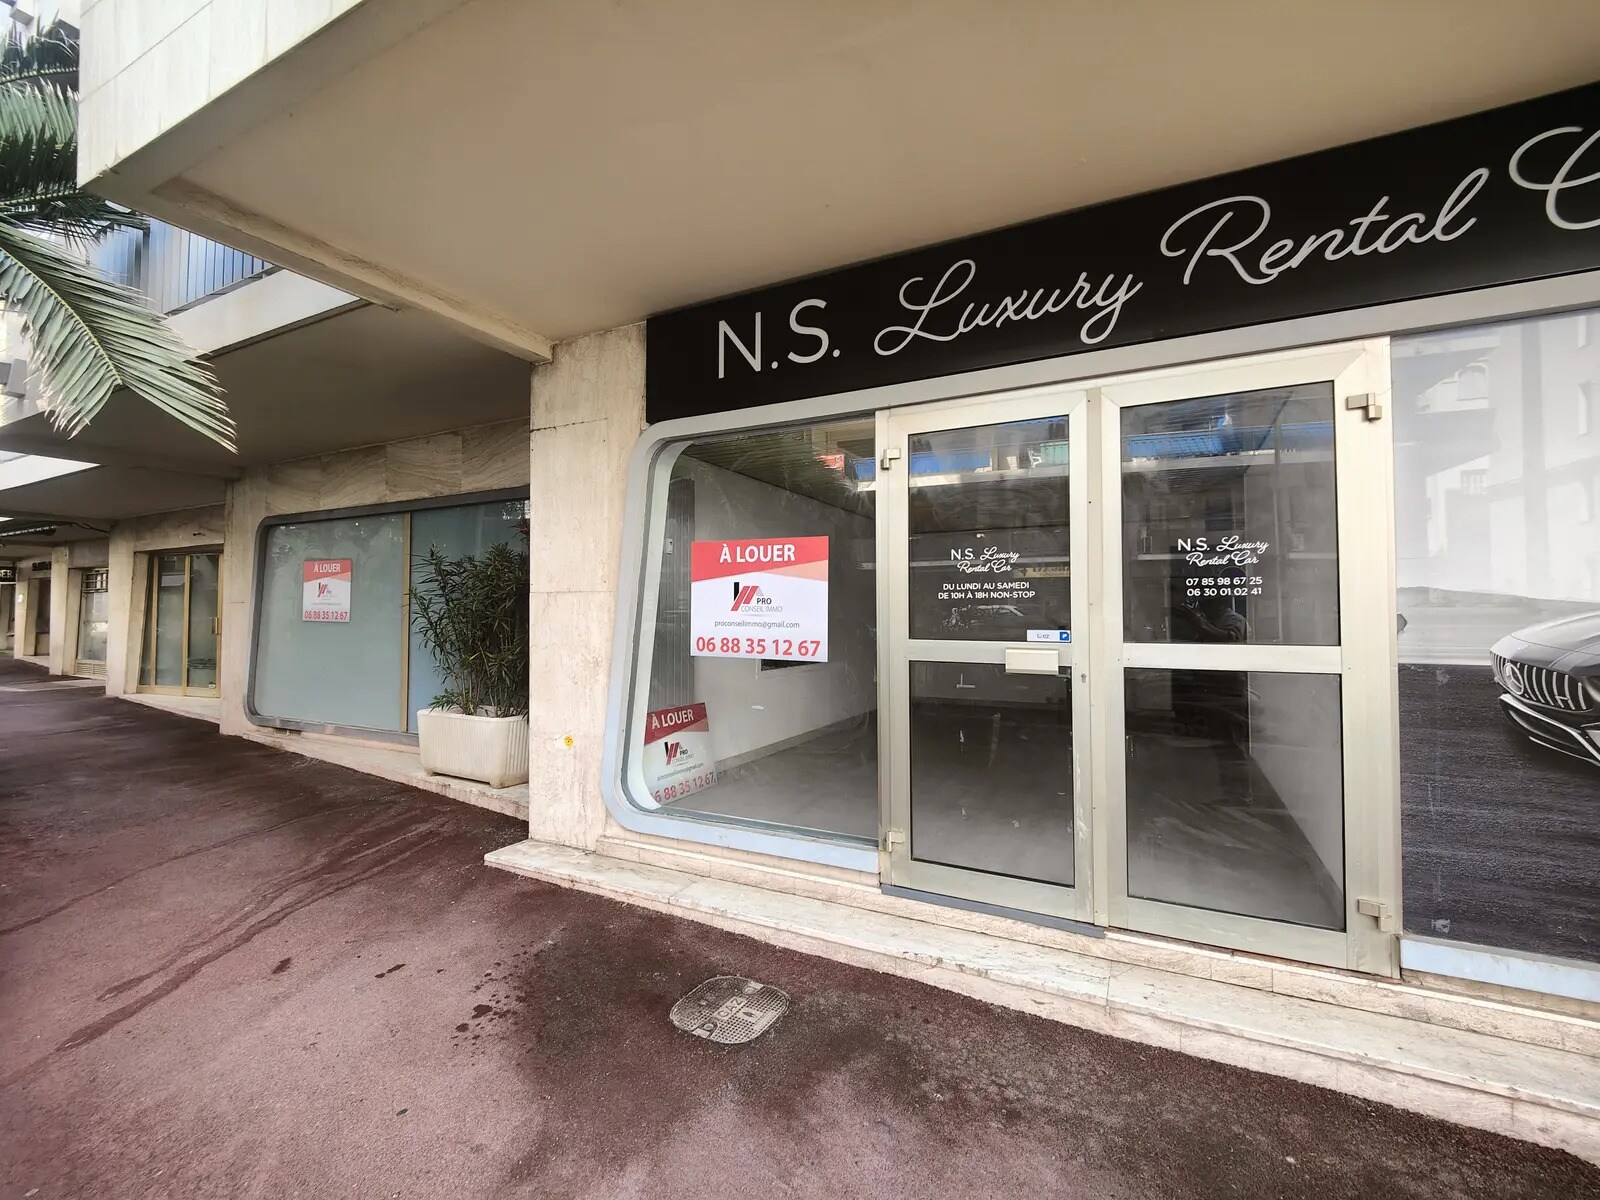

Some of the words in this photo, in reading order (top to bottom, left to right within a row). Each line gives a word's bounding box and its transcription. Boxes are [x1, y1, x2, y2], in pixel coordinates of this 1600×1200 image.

[718, 298, 841, 379] N.S.
[873, 259, 1144, 357] Luxury
[1160, 167, 1490, 286] Rental
[719, 543, 732, 563] À
[736, 544, 796, 562] LOUER
[1177, 537, 1210, 551] N.S.
[1216, 535, 1269, 554] Luxury
[951, 548, 976, 561] N.S.
[980, 546, 1020, 563] Luxury
[1185, 552, 1230, 567] Rental
[1231, 550, 1260, 566] Car
[320, 563, 341, 573] LOUER
[957, 561, 991, 574] Rental
[991, 559, 1013, 573] Car
[983, 582, 995, 590] AU
[997, 581, 1030, 589] SAMEDI
[1185, 578, 1199, 586] 07
[1201, 577, 1215, 586] 85
[1217, 577, 1231, 586] 98
[1233, 577, 1247, 585] 67
[1249, 576, 1263, 585] 25
[938, 592, 949, 600] DE
[966, 590, 973, 599] À
[975, 591, 989, 599] 18H
[990, 591, 1036, 599] NON-STOP
[1186, 588, 1201, 596] 06
[1203, 588, 1217, 596] 30
[1219, 588, 1231, 596] 01
[1233, 587, 1248, 596] 02
[1250, 587, 1262, 595] 41
[756, 597, 772, 605] PRO
[696, 637, 716, 653] 06
[720, 637, 741, 653] 88
[745, 638, 767, 655] 35
[772, 639, 794, 656] 12
[798, 640, 821, 657] 67
[652, 713, 660, 730] À
[661, 709, 694, 728] LOUER
[663, 785, 677, 800] 88
[678, 780, 691, 795] 35
[693, 775, 704, 789] 12
[716, 998, 744, 1018] GAZ
